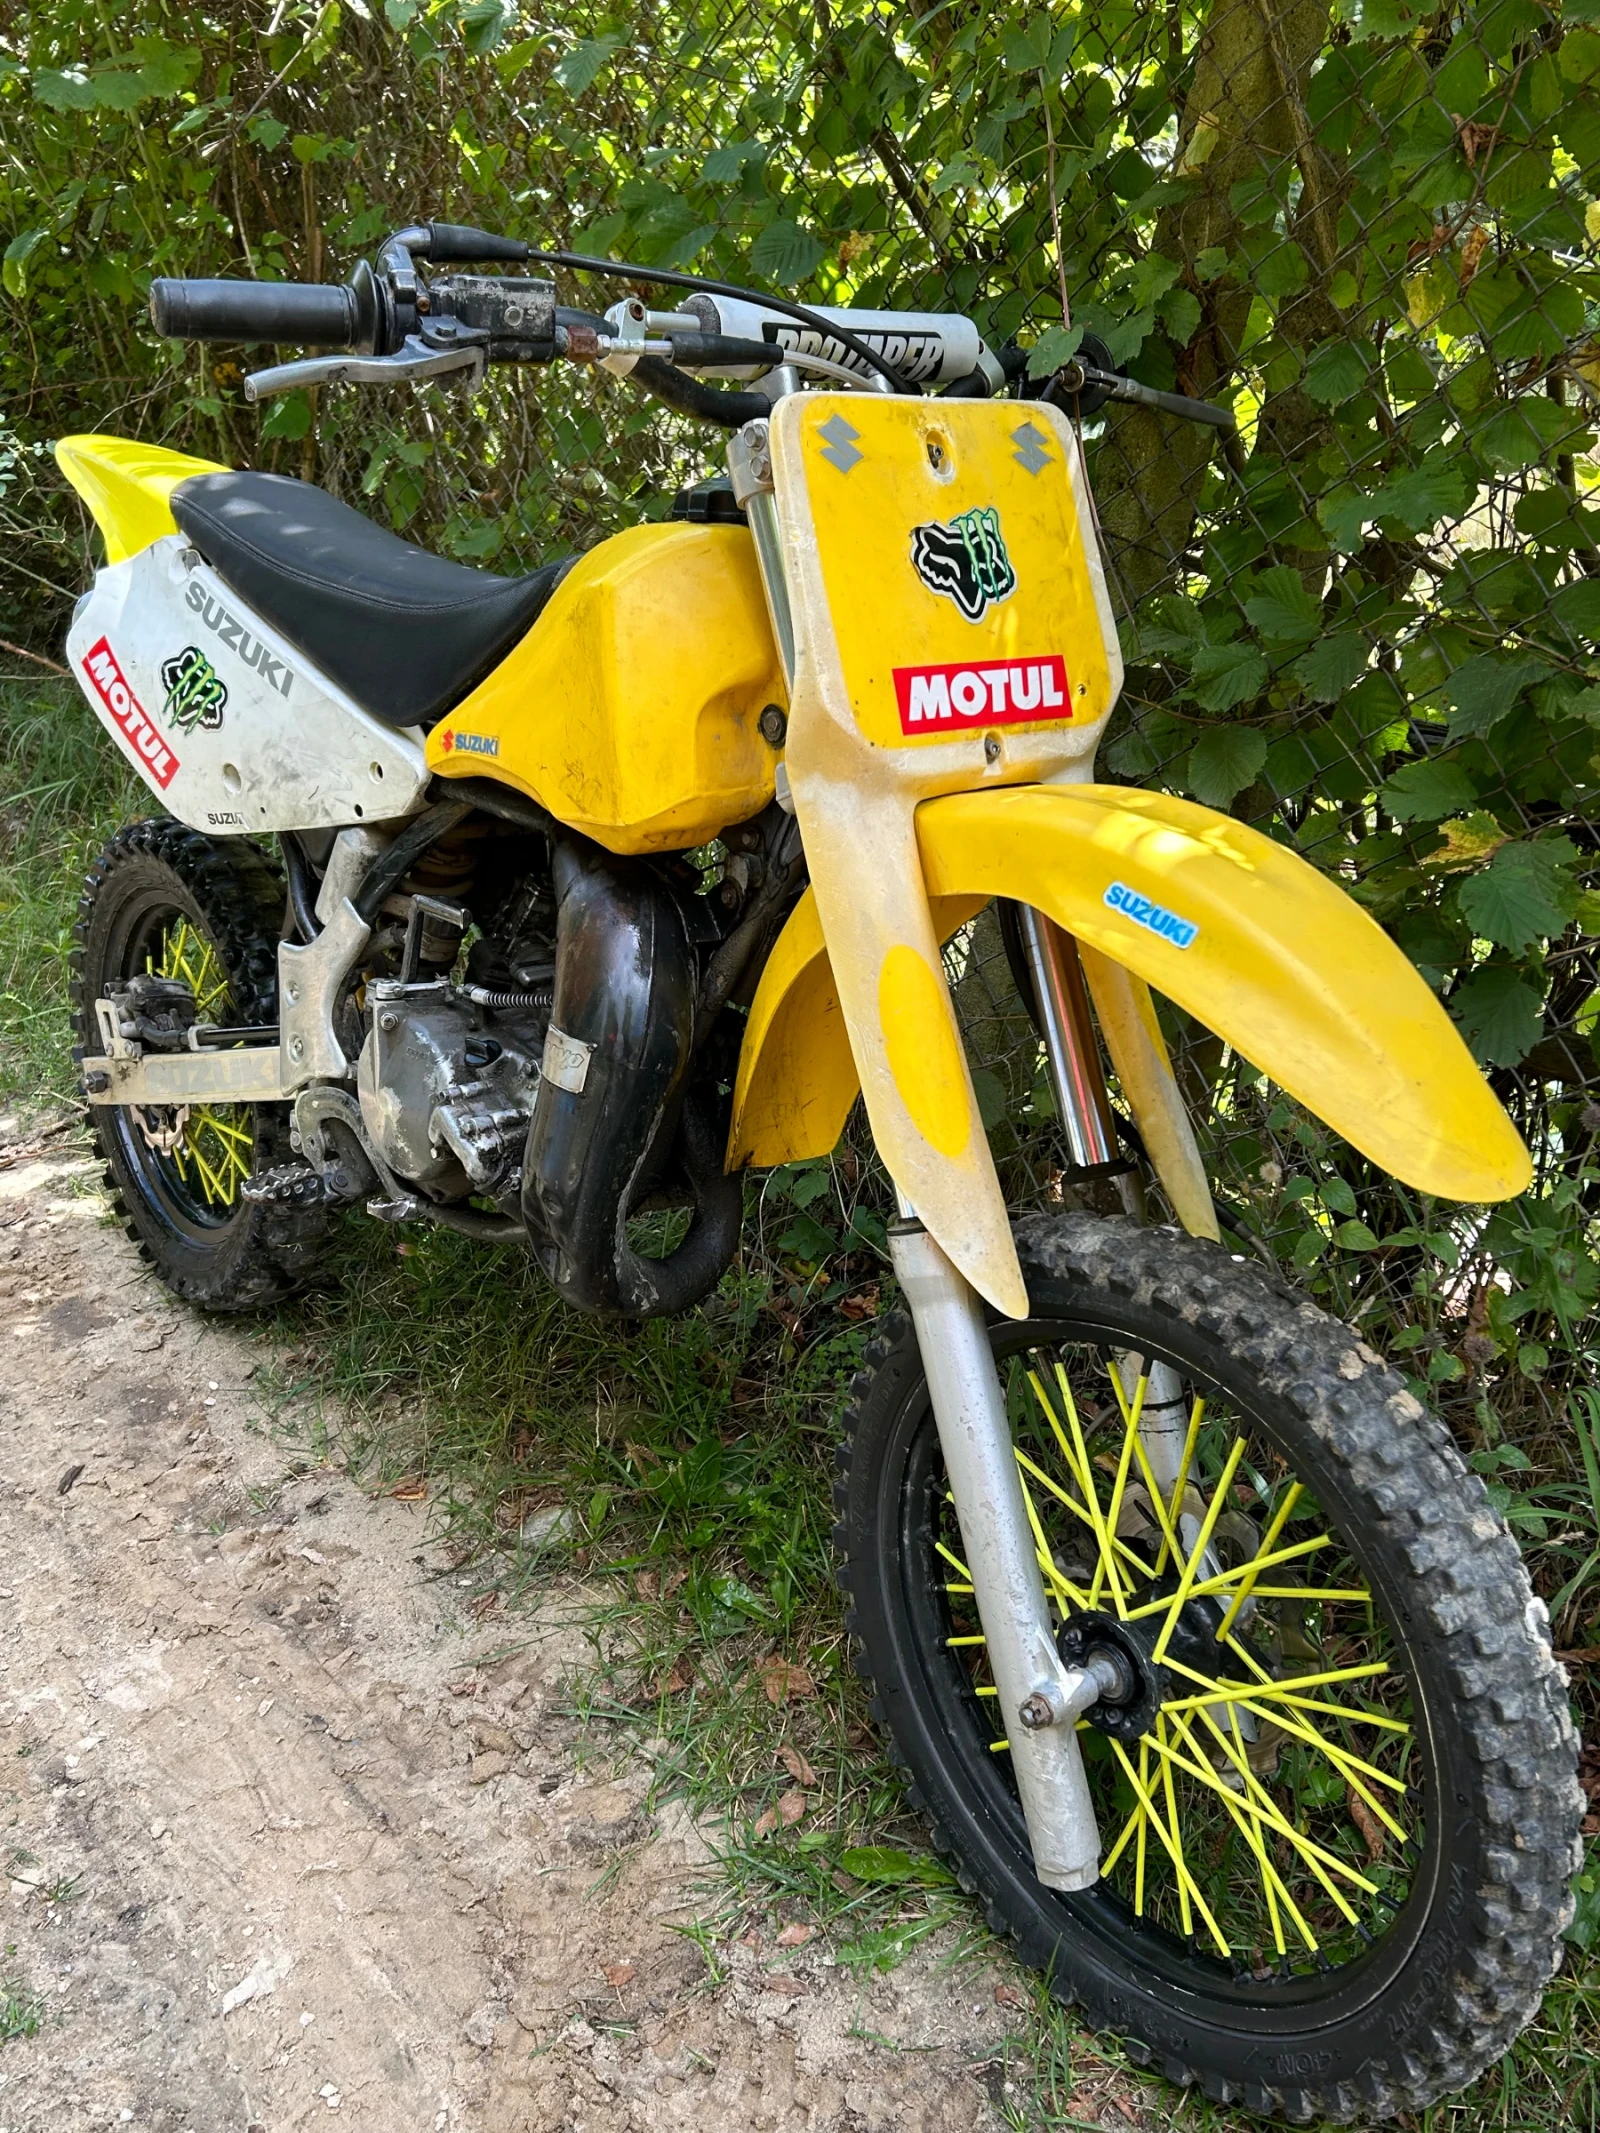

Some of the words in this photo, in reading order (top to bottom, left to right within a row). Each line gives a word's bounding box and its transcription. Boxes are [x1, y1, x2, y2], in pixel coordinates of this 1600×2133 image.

[185, 581, 294, 698] SUZUKI
[89, 650, 168, 780] MOTUL
[908, 664, 1064, 722] MOTUL
[455, 733, 498, 756] SUZUKI
[1106, 885, 1194, 946] SUZUKI
